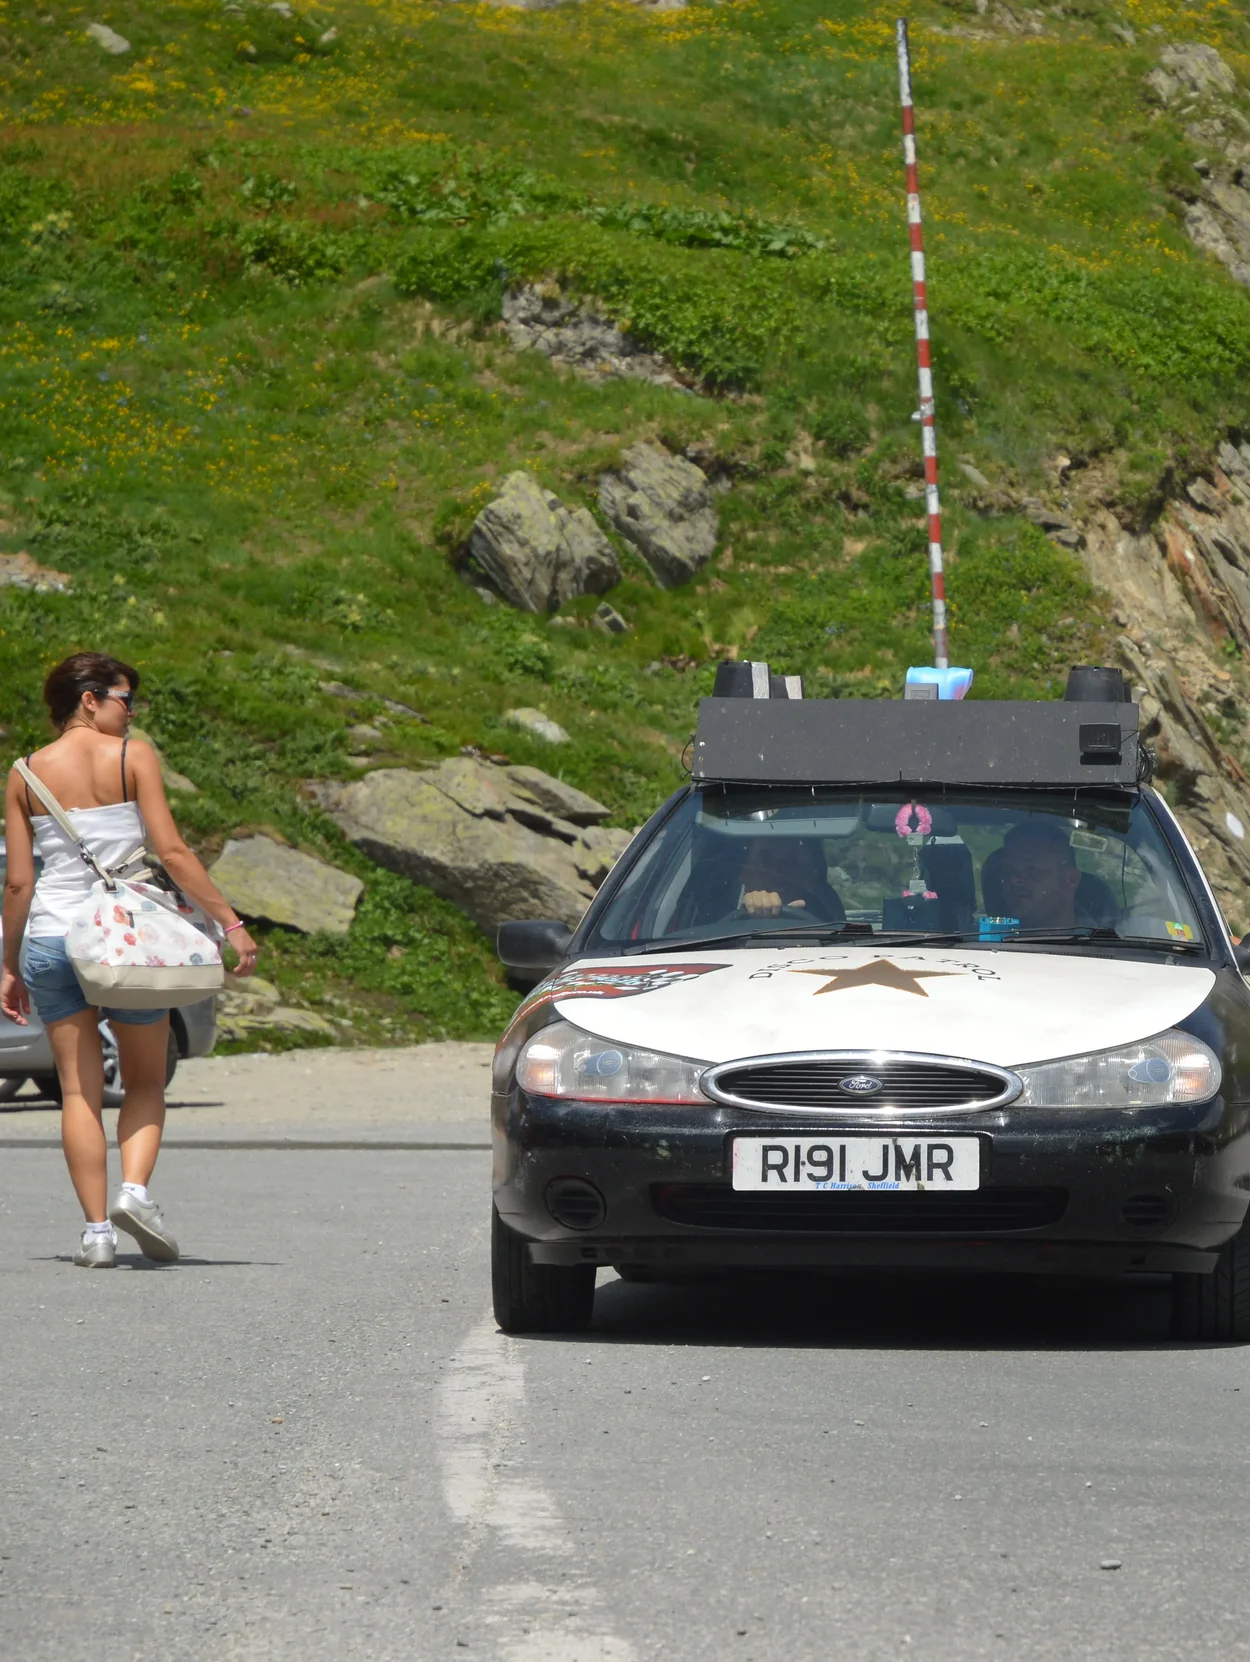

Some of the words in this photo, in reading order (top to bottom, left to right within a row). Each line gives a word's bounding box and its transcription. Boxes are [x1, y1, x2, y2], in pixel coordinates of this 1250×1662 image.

[748, 956, 849, 979] DISCO
[849, 1079, 872, 1090] Ford
[761, 1144, 847, 1183] R191
[862, 1143, 954, 1183] JMR
[867, 1181, 900, 1189] Sheffield
